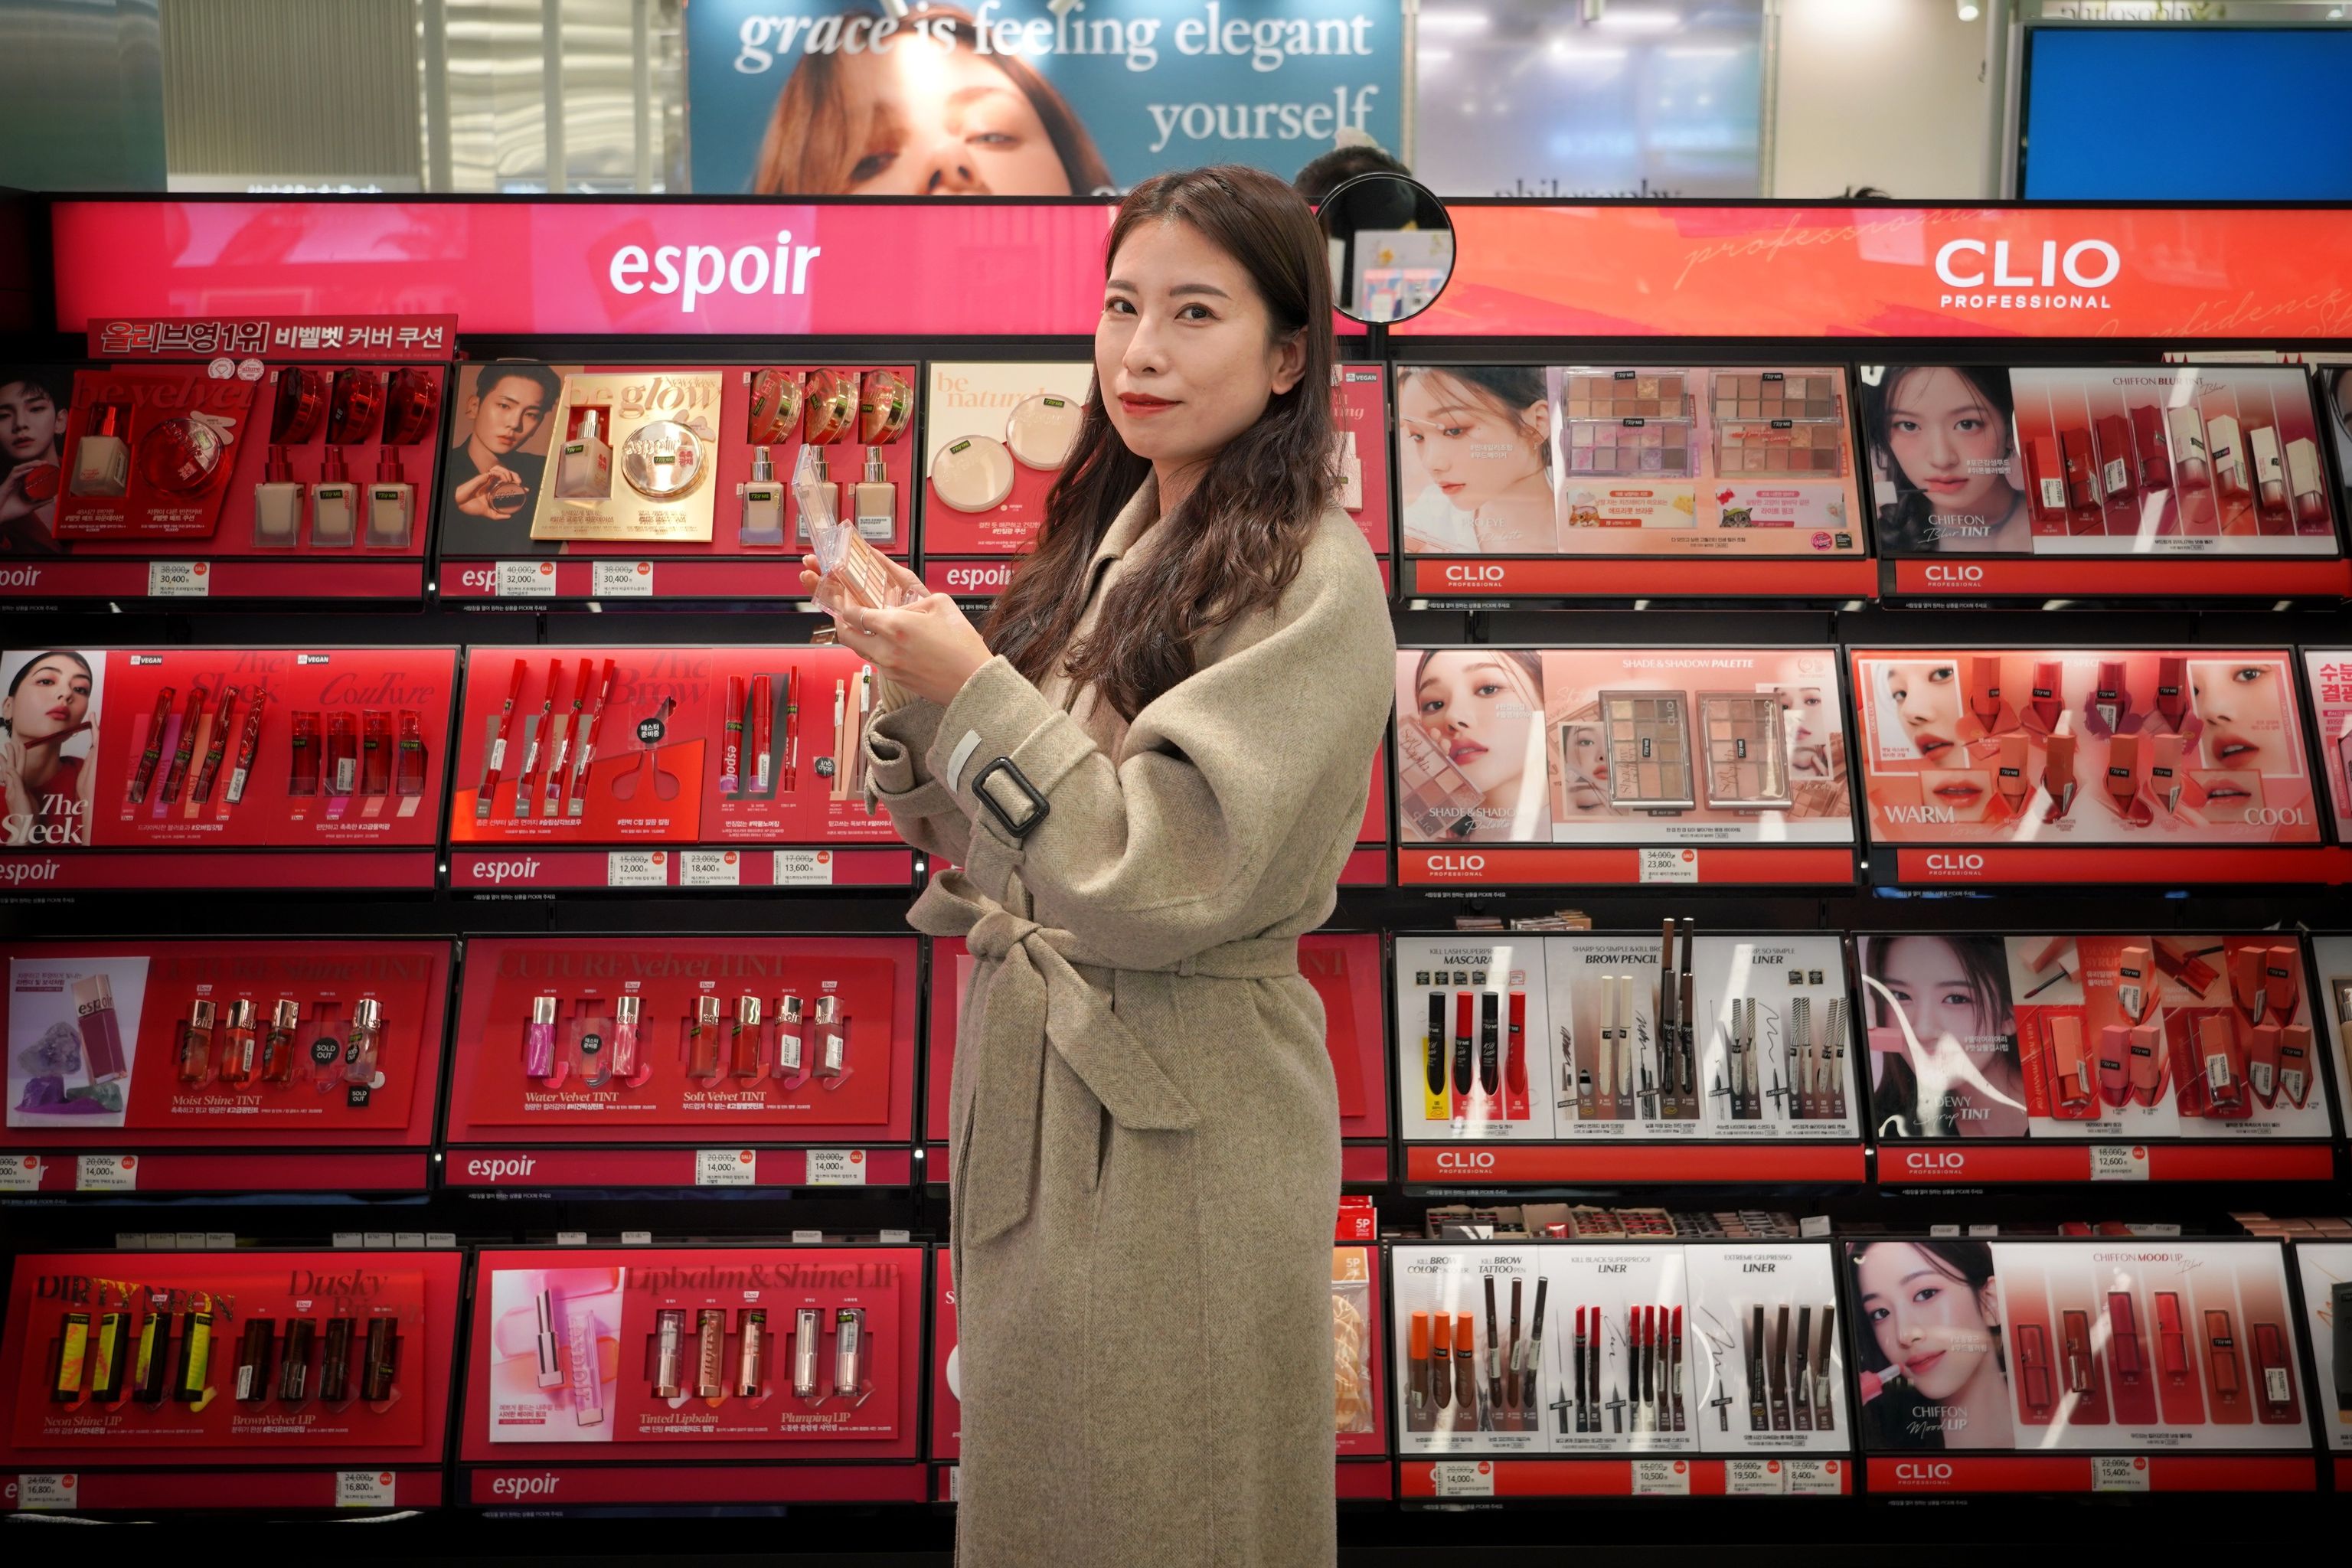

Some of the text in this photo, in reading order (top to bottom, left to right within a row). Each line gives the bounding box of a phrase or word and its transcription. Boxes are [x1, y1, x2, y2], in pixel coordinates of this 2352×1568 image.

[734, 0, 1374, 74] grace is feeling elegant
[1147, 85, 1378, 152] yourself
[1936, 239, 2120, 288] CLIO
[609, 229, 821, 313] espoir
[1940, 295, 2111, 309] PROFESSIONAL
[275, 326, 343, 349] 비벨벳
[346, 326, 392, 349] 커버
[397, 326, 443, 349] 쿠션
[937, 372, 968, 392] be
[2113, 377, 2157, 386] CHIFFON
[619, 377, 721, 419] glow
[1928, 515, 1984, 525] CHIFFON
[1960, 526, 1990, 537] TINT
[1446, 566, 1504, 581] CLIO
[1925, 566, 1983, 580] CLIO
[1622, 660, 1753, 668] SHADE SHADOW PALETTE
[724, 746, 736, 782] espoir
[39, 794, 89, 815] The
[1429, 808, 1467, 817] SHADE
[1884, 805, 1954, 823] WARM
[2244, 808, 2309, 825] COOL
[0, 813, 85, 844] Sleek
[1427, 855, 1485, 871] CLIO
[1926, 854, 1984, 870] CLIO
[473, 858, 540, 884] espoir
[1443, 956, 1494, 965] MASCARA
[1586, 955, 1658, 964] BROW PENCIL
[1753, 955, 1783, 965] LINER
[172, 1096, 263, 1106] Moist Shine TINT
[525, 1092, 619, 1102] Water Velvet TINT
[684, 1091, 766, 1101] Soft Velvet TINT
[1934, 1096, 1971, 1108] DEWY
[1960, 1108, 1991, 1119] TINT
[1436, 1152, 1494, 1168] CLIO
[1906, 1153, 1964, 1168] CLIO
[468, 1155, 536, 1181] espoir
[1355, 1218, 1370, 1228] 5P
[1494, 1256, 1522, 1265] BROW
[2093, 1253, 2183, 1262] CHIFFON MOOD LIP
[1407, 1266, 1438, 1274] COLOR
[1479, 1266, 1513, 1274] TATTOO
[1598, 1264, 1626, 1272] LINER
[1743, 1263, 1775, 1272] LINER
[288, 1269, 387, 1300] Dusky
[773, 1267, 900, 1292] Shine LIP
[37, 1276, 139, 1311] DIRTY
[782, 1412, 851, 1426] Plumping LIP
[1912, 1406, 1968, 1418] CHIFFON
[44, 1416, 122, 1426] Neon Shine LIP
[298, 1415, 315, 1425] LIP
[640, 1414, 718, 1426] Tinted Lipbalm
[1906, 1418, 1968, 1439] Mood LIP
[1896, 1464, 1952, 1479] CLIO
[493, 1473, 560, 1499] espoir
